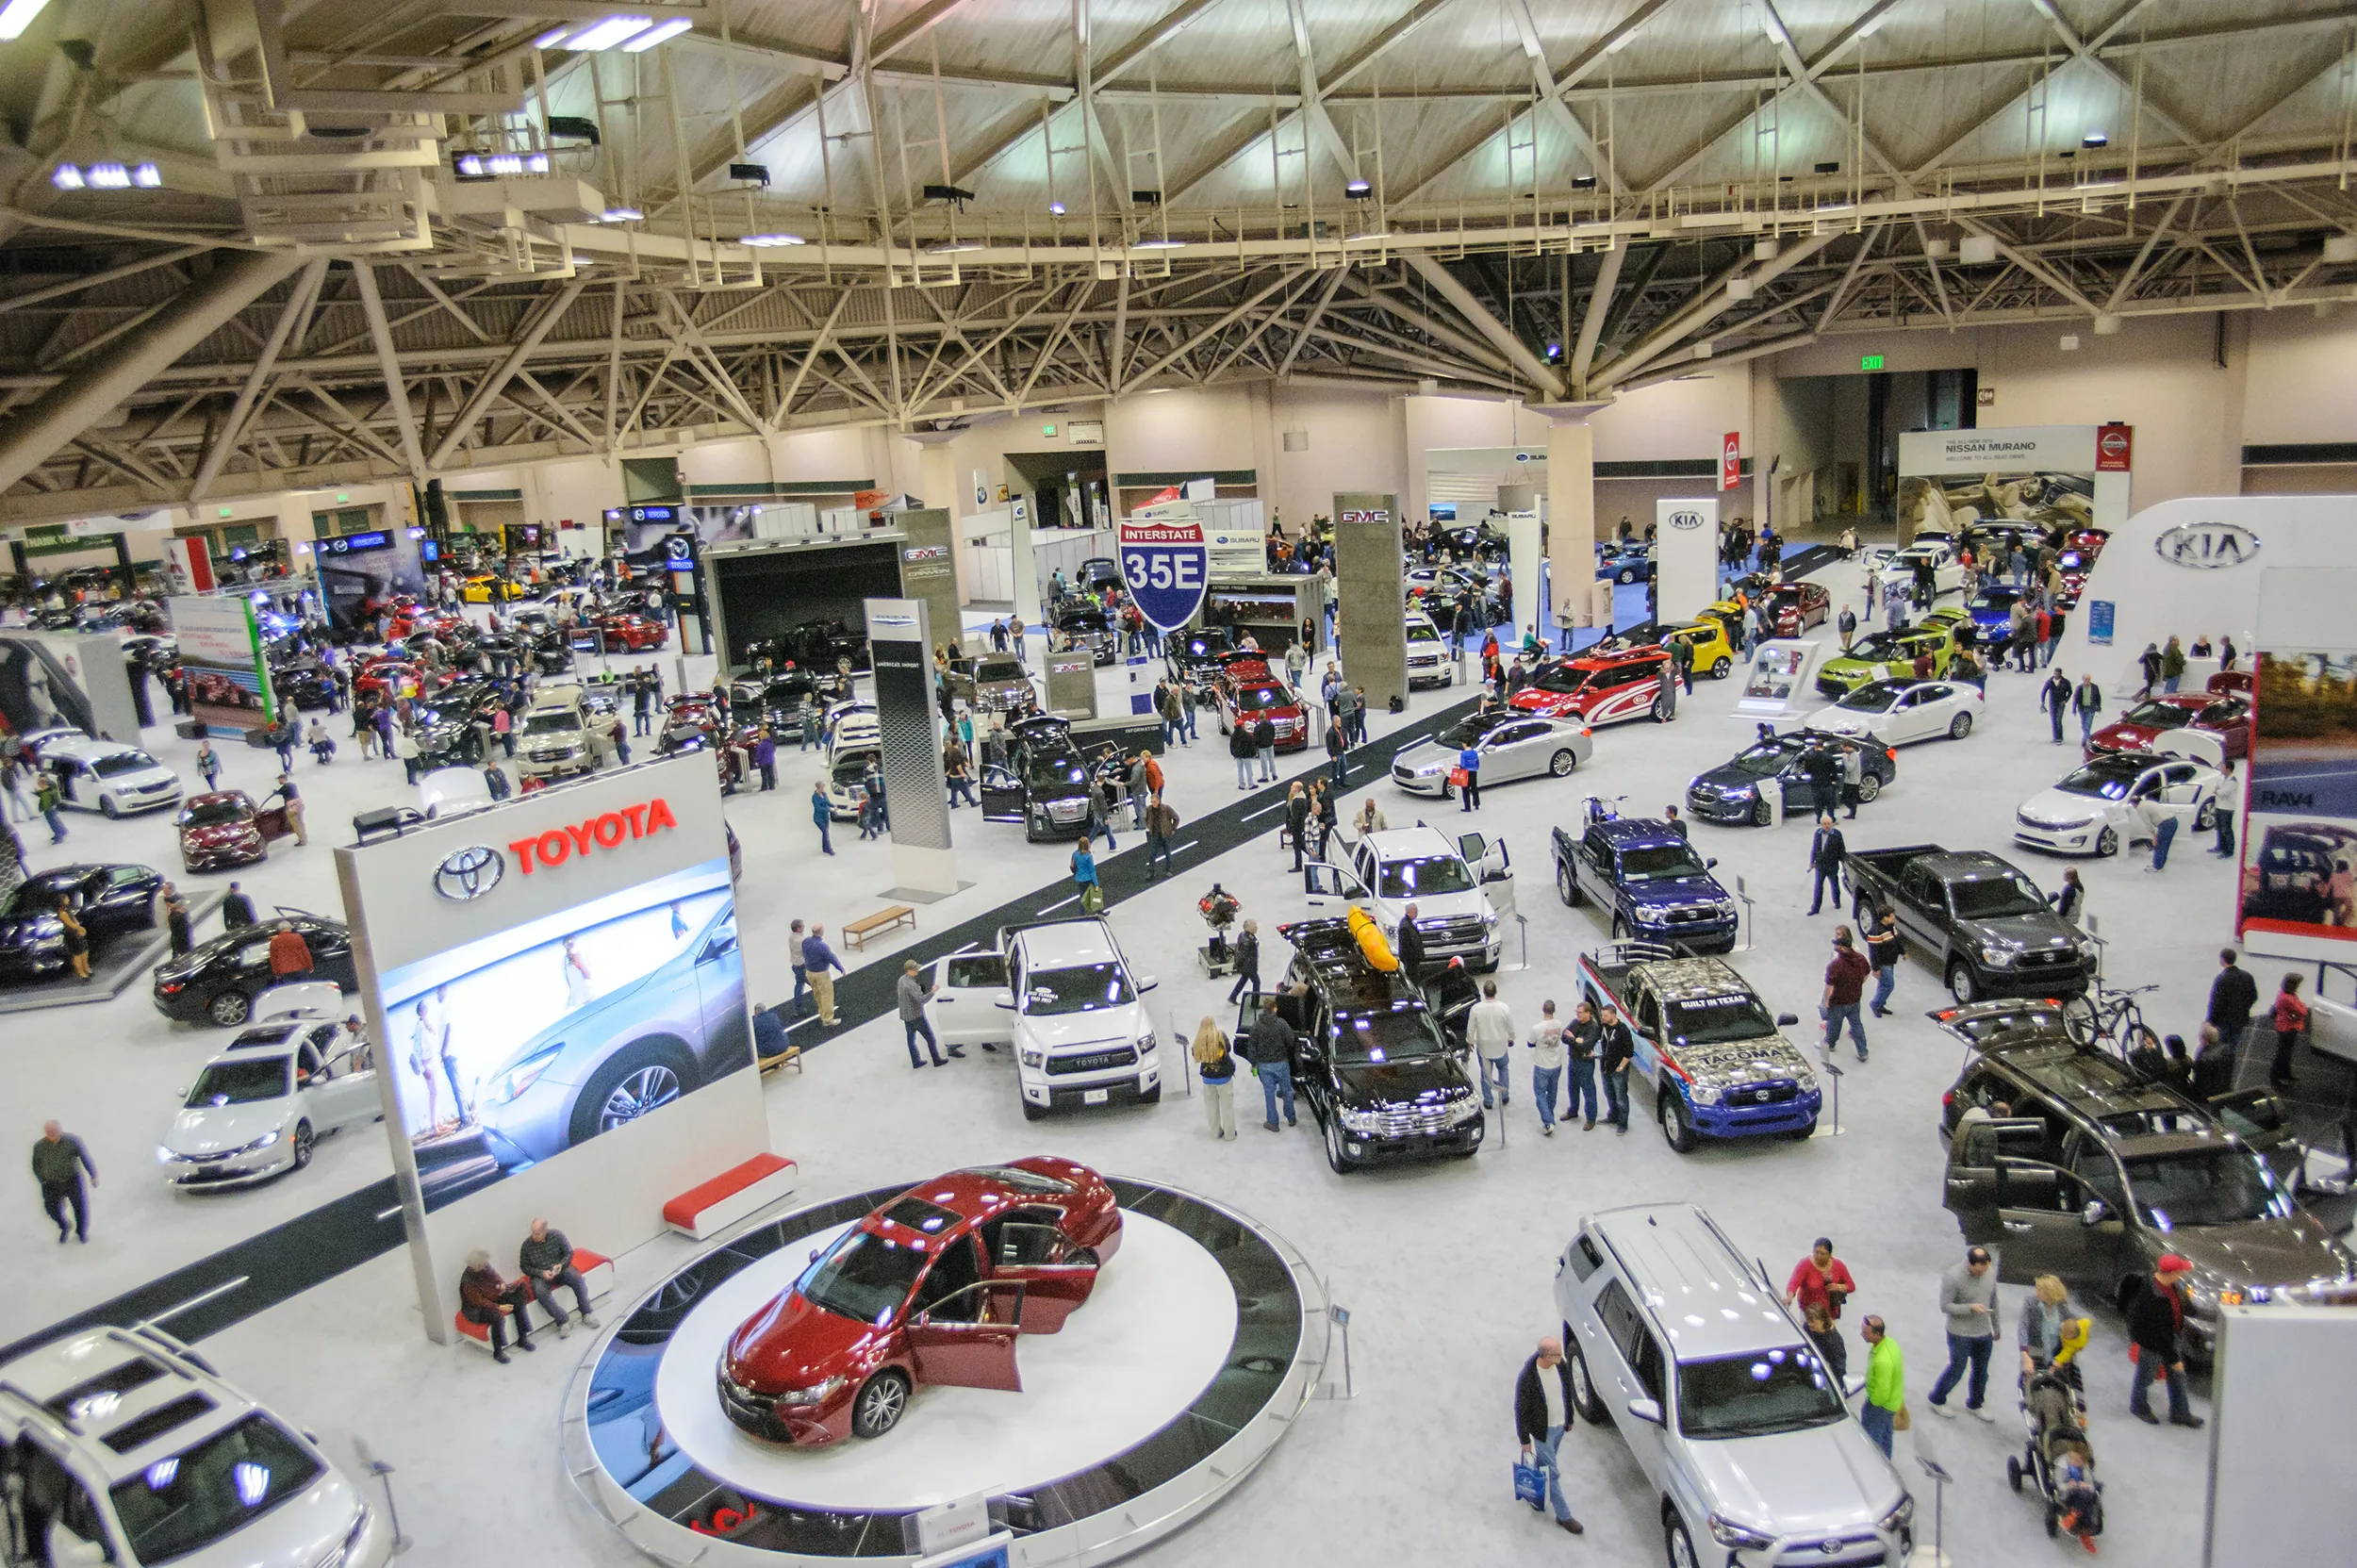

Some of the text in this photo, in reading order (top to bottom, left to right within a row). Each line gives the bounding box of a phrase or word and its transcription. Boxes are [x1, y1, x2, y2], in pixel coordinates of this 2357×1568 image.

[1861, 355, 1884, 371] EXIT
[1946, 441, 2036, 453] NISSAN MURANO
[1341, 510, 1390, 523] GMC
[1674, 515, 1698, 525] KIA
[1125, 530, 1196, 540] INTERSTATE
[2173, 534, 2241, 559] KIA
[905, 547, 948, 561] GMC
[1127, 553, 1202, 589] 35E
[1053, 662, 1087, 673] GMC
[1125, 725, 1160, 734] INFORMATION
[2262, 790, 2314, 807] RAV4
[508, 798, 679, 876] TOYOTA
[1680, 999, 1706, 1009] BUILT
[1716, 995, 1747, 1005] TEXAS
[1076, 1056, 1110, 1067] TOYOTA
[1698, 1048, 1784, 1065] TACOMA
[948, 1521, 976, 1534] TOYOTA
